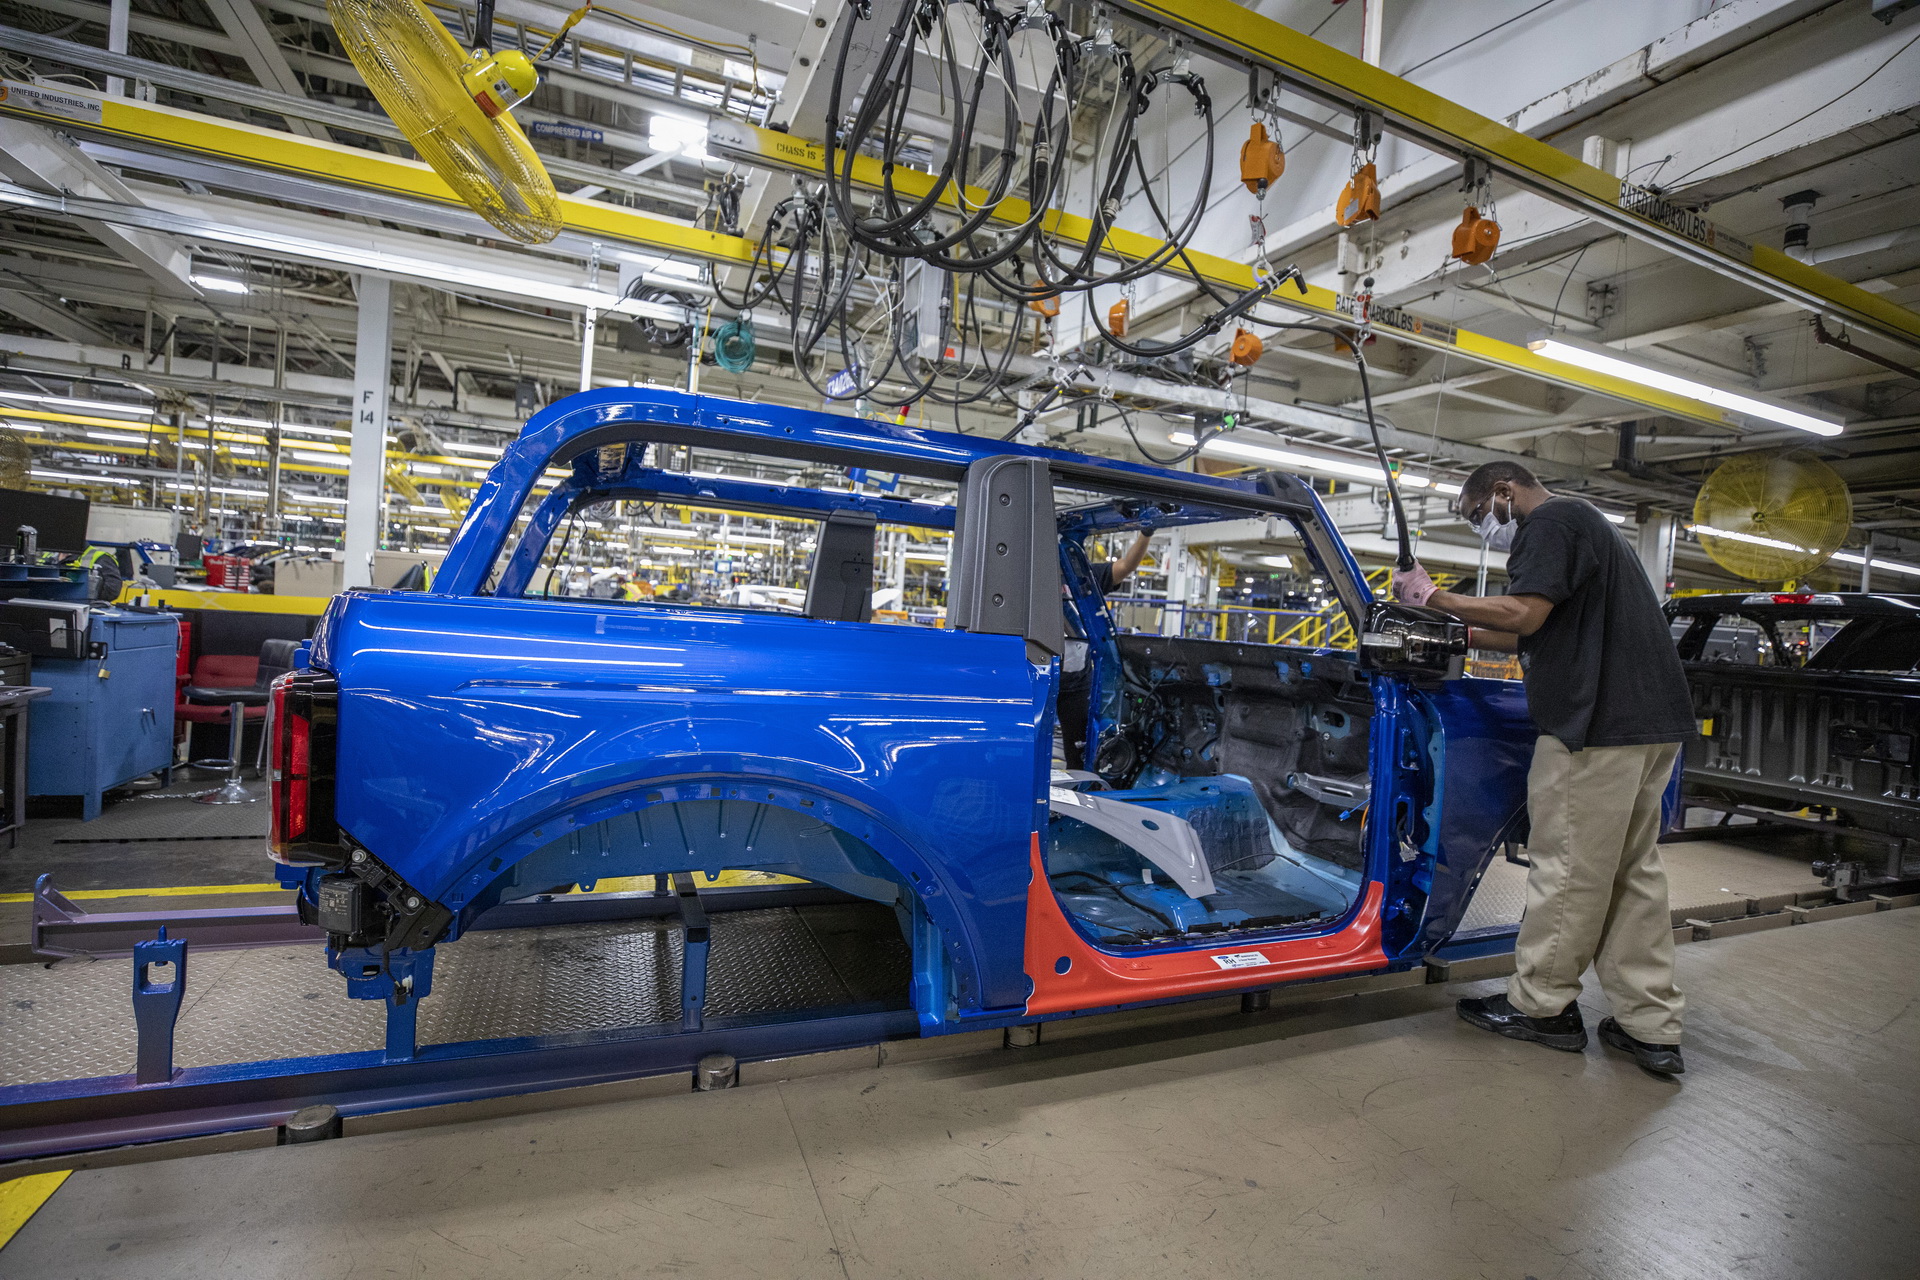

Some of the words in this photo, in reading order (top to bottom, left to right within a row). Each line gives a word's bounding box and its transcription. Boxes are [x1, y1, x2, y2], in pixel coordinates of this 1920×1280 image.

[11, 86, 40, 98] UNIFIED
[535, 123, 580, 137] COMPRESSED
[581, 129, 593, 139] AIR
[1336, 293, 1355, 317] RATE
[363, 390, 374, 404] F
[360, 409, 374, 424] 14
